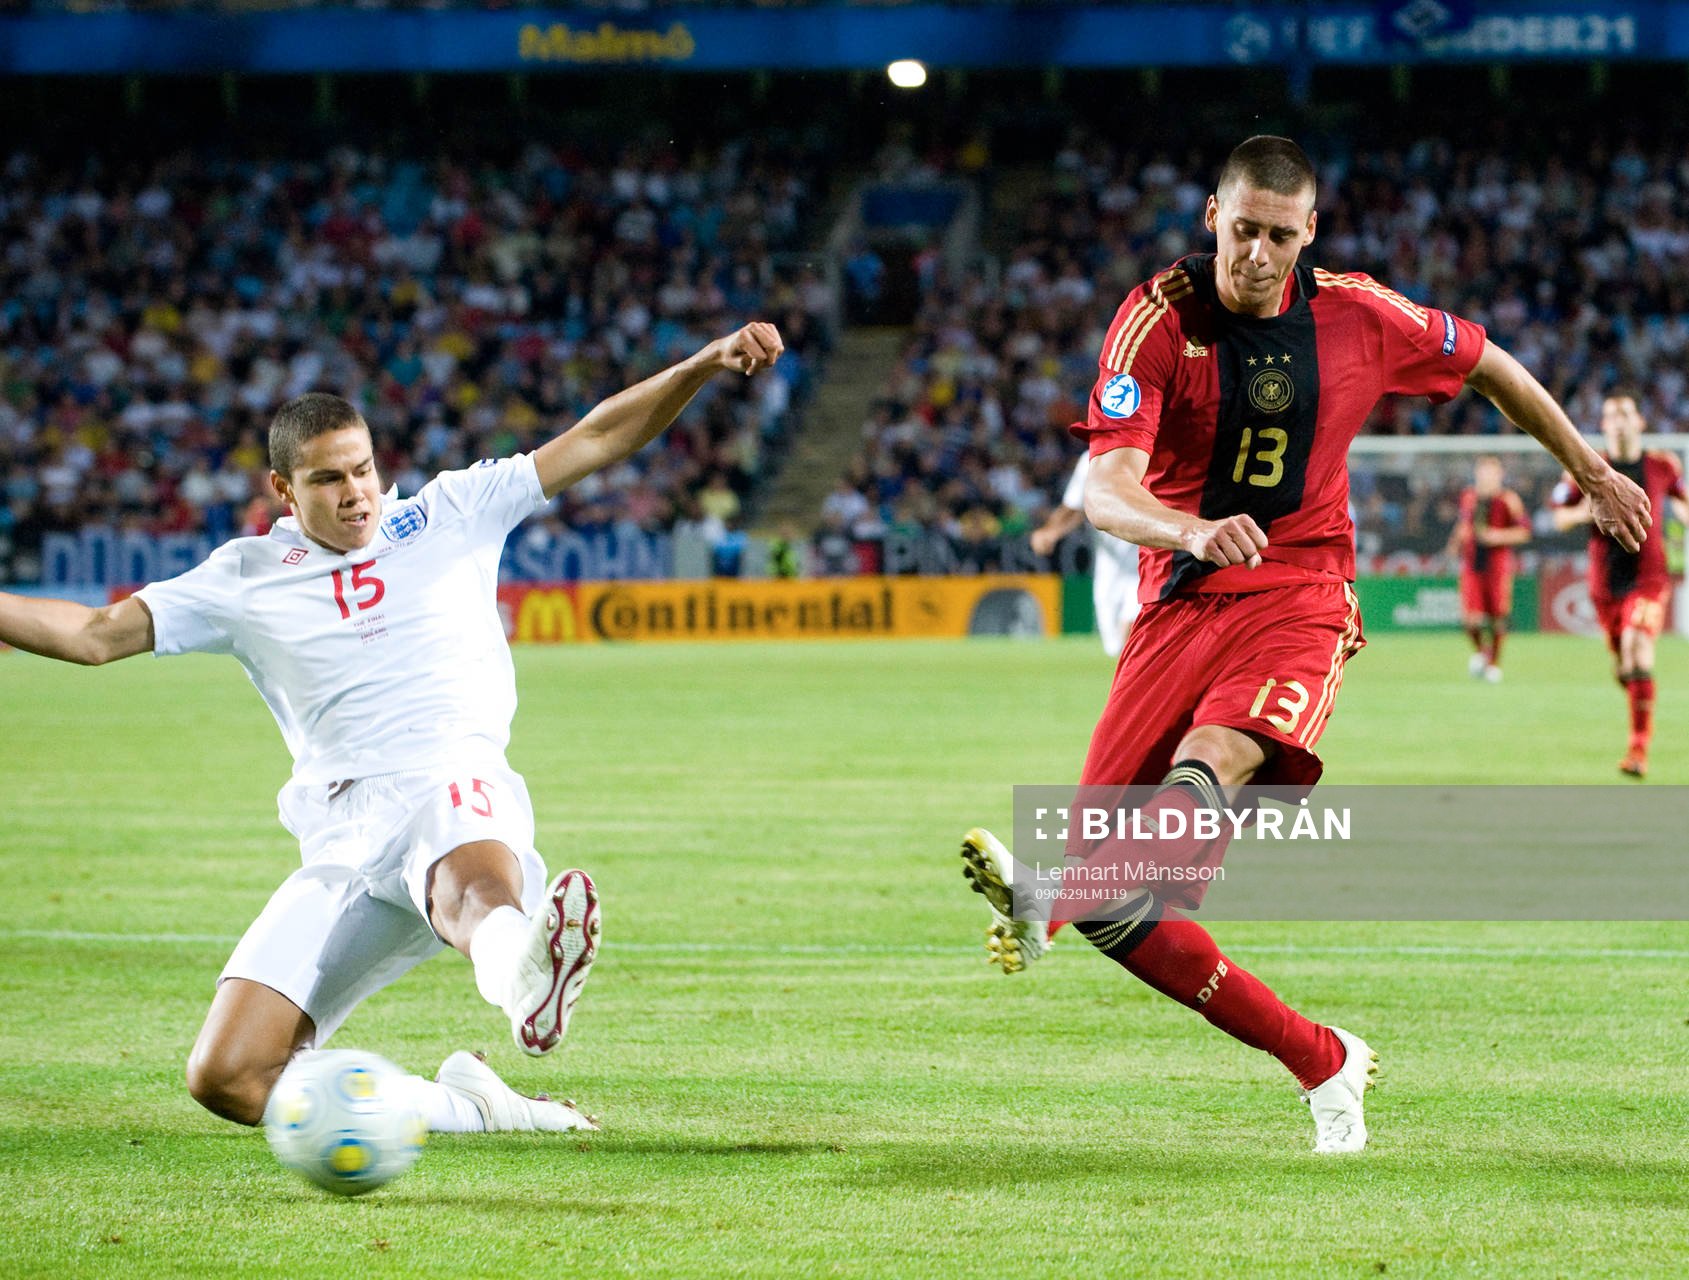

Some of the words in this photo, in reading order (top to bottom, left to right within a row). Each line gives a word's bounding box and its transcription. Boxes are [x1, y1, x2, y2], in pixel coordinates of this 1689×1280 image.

[1232, 427, 1288, 487] 13
[331, 559, 385, 619] 15
[590, 582, 894, 641] Continental
[1249, 678, 1309, 734] 13
[448, 778, 494, 818] 15
[1197, 960, 1228, 1004] DFB
